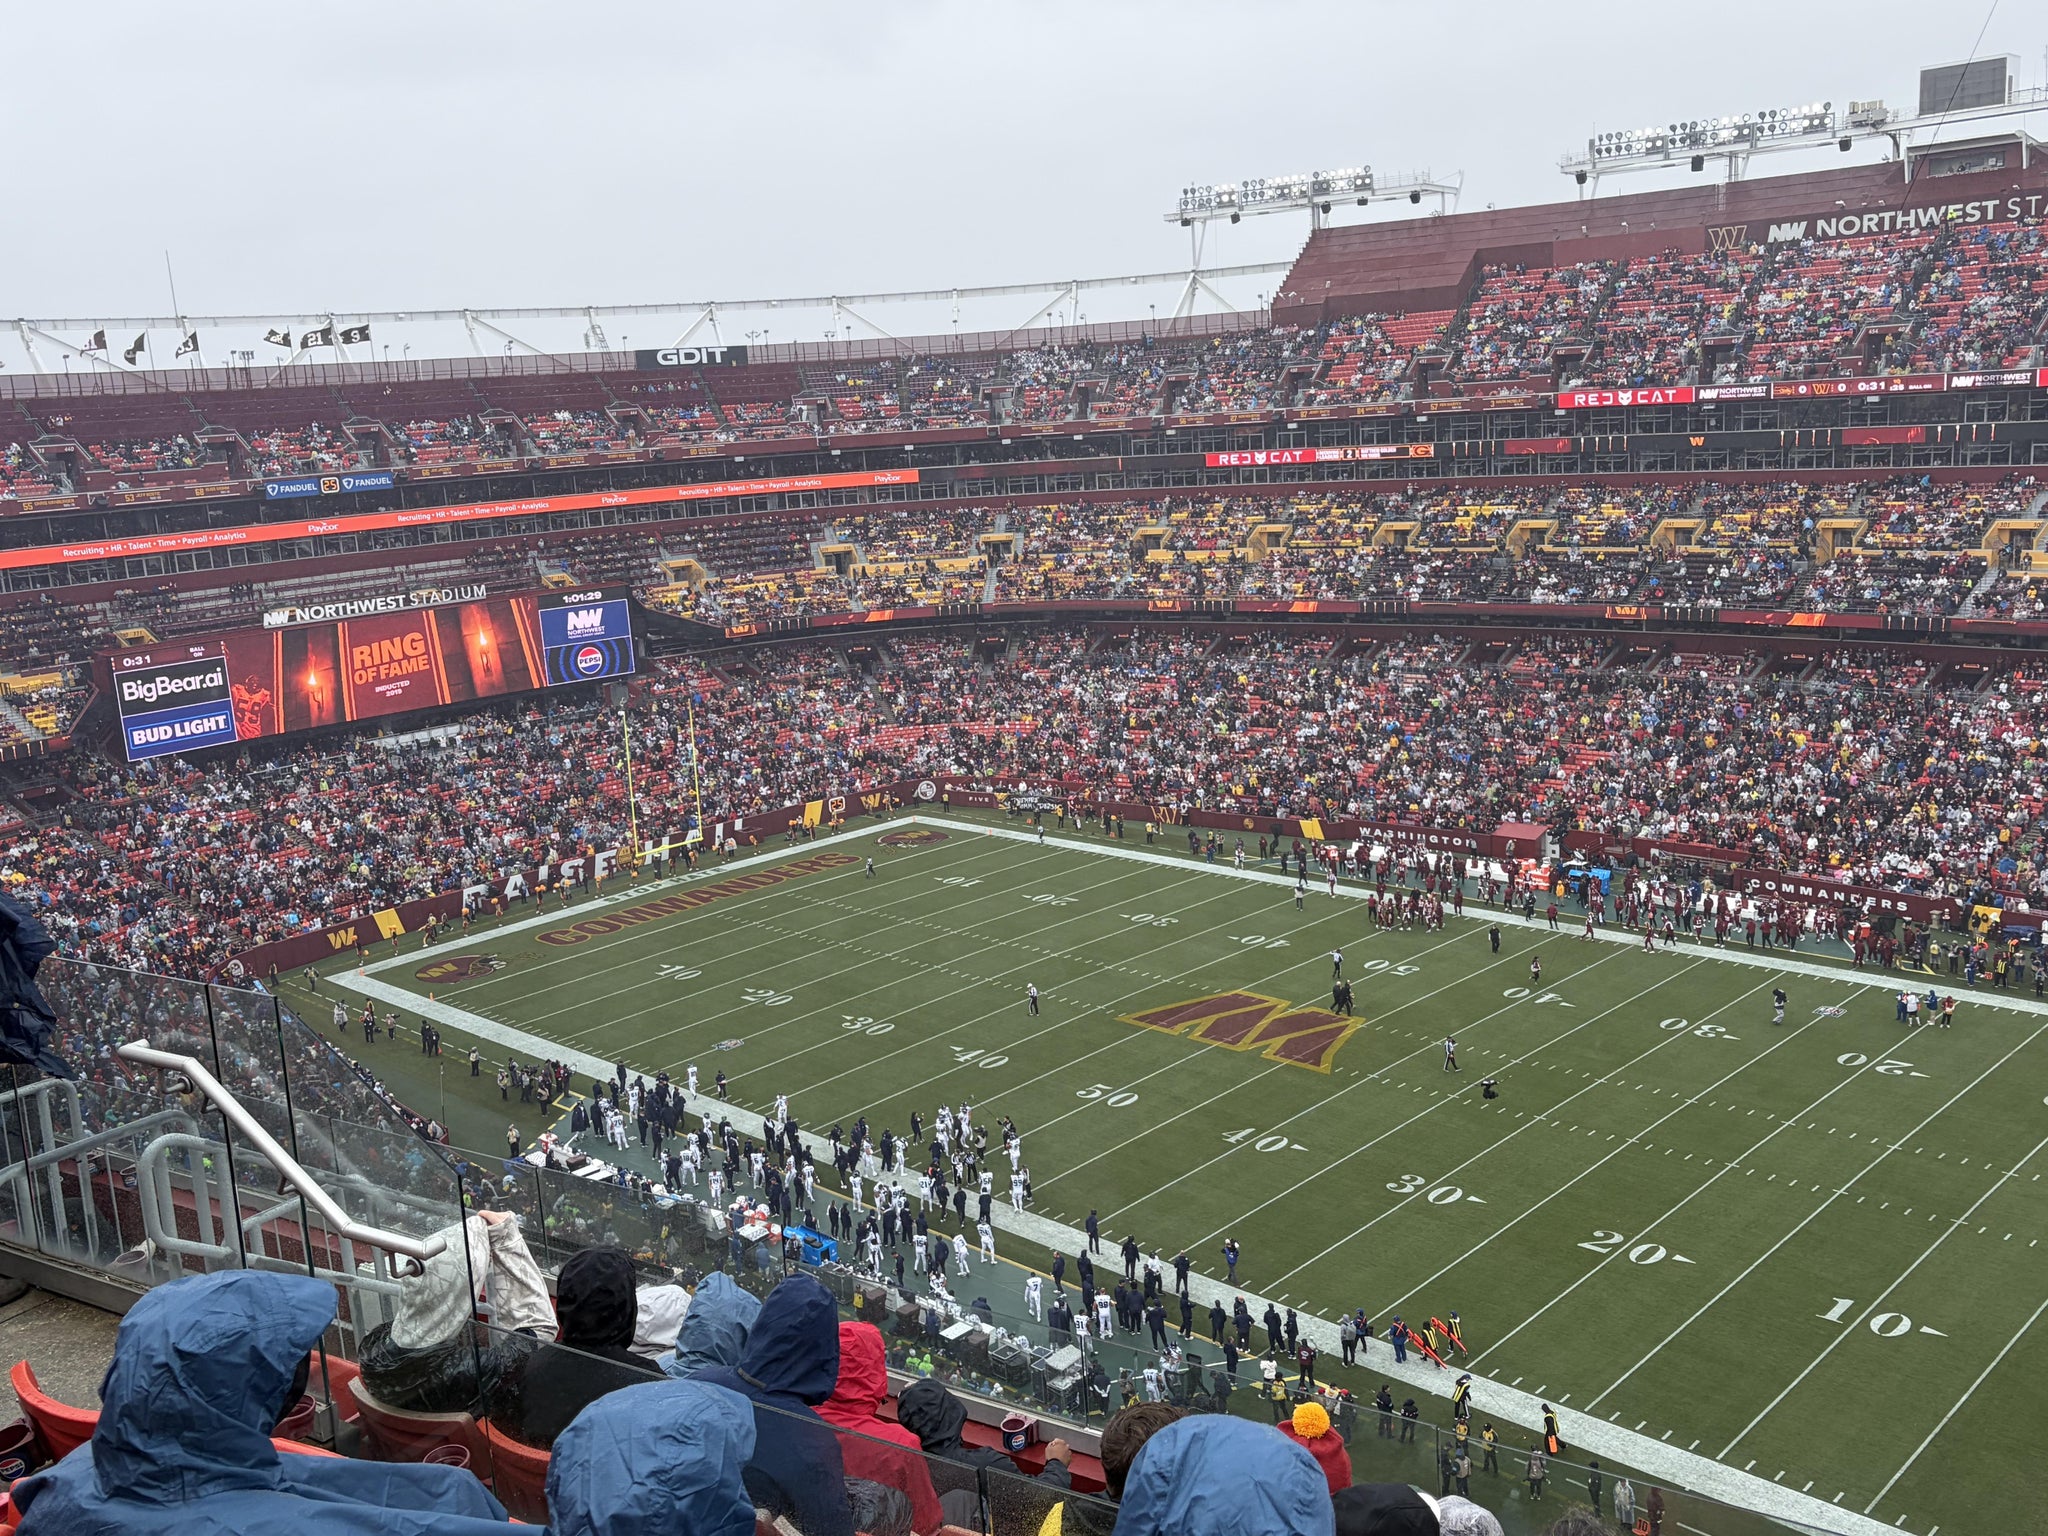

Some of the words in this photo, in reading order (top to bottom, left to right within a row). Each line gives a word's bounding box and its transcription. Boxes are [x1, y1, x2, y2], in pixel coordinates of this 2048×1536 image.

[1767, 221, 1808, 244] NW
[1816, 200, 2000, 238] NORTHWEST
[307, 332, 324, 346] 21
[656, 348, 727, 366] GDIT
[1838, 384, 1846, 392] 0
[1858, 382, 1886, 391] 0:31
[1951, 376, 1975, 387] NW
[1975, 373, 2032, 382] NORTHWEST
[1637, 390, 1676, 403] CAT
[1700, 388, 1719, 399] NW
[1719, 386, 1767, 395] NORTHWEST
[1798, 385, 1807, 394] 0
[1689, 437, 1705, 446] W
[1270, 451, 1303, 463] CAT
[1347, 450, 1352, 458] 2
[280, 483, 317, 494] FANDUEL
[355, 476, 392, 486] FANDUEL
[323, 480, 337, 490] 25
[874, 474, 901, 483] Paycor
[679, 487, 709, 496] Recruiting
[769, 482, 789, 490] Payroll
[794, 479, 822, 487] Analytics
[23, 502, 33, 510] 55
[601, 496, 628, 504] Paycor
[397, 512, 430, 522] Recruiting
[495, 505, 516, 514] Payroll
[521, 502, 549, 511] Analytics
[308, 524, 338, 533] Paycor
[63, 546, 104, 557] Recruiting
[128, 541, 151, 549] Talent
[158, 538, 176, 547] Time
[182, 536, 207, 545] Payroll
[214, 532, 246, 542] Analytics
[563, 591, 602, 603] 1:01:29
[263, 612, 290, 627] NW
[296, 595, 406, 621] NORTHWEST
[410, 585, 486, 607] STADIUM
[568, 608, 603, 630] NW
[568, 625, 605, 636] NORTHWEST
[353, 632, 425, 669] RING
[123, 655, 151, 666] 0:31
[354, 666, 377, 685] OF
[380, 654, 430, 680] FAME
[122, 667, 223, 702] BigBear.ai
[375, 680, 410, 693] INDUCTED
[132, 726, 172, 745] BUD
[174, 715, 226, 737] LIGHT
[831, 798, 843, 808] 25
[601, 883, 662, 903] STOP
[668, 868, 728, 882] HATE
[946, 876, 984, 888] 10
[534, 852, 862, 946] COMMANDERS
[1036, 893, 1079, 906] 20
[1130, 912, 1179, 927] 30
[326, 927, 358, 949] W
[1240, 934, 1290, 949] 40
[661, 966, 702, 981] 10
[1363, 959, 1420, 976] 50
[741, 989, 793, 1007] 20
[1503, 987, 1563, 1004] 40
[841, 1017, 895, 1036] 30
[1660, 1018, 1726, 1038] 30
[954, 1047, 1009, 1069] 40
[1836, 1052, 1914, 1076] 20
[1076, 1084, 1138, 1107] 50
[1222, 1127, 1289, 1152] 40
[1386, 1173, 1463, 1205] 30
[1577, 1230, 1667, 1264] 20
[1816, 1297, 1912, 1337] 10
